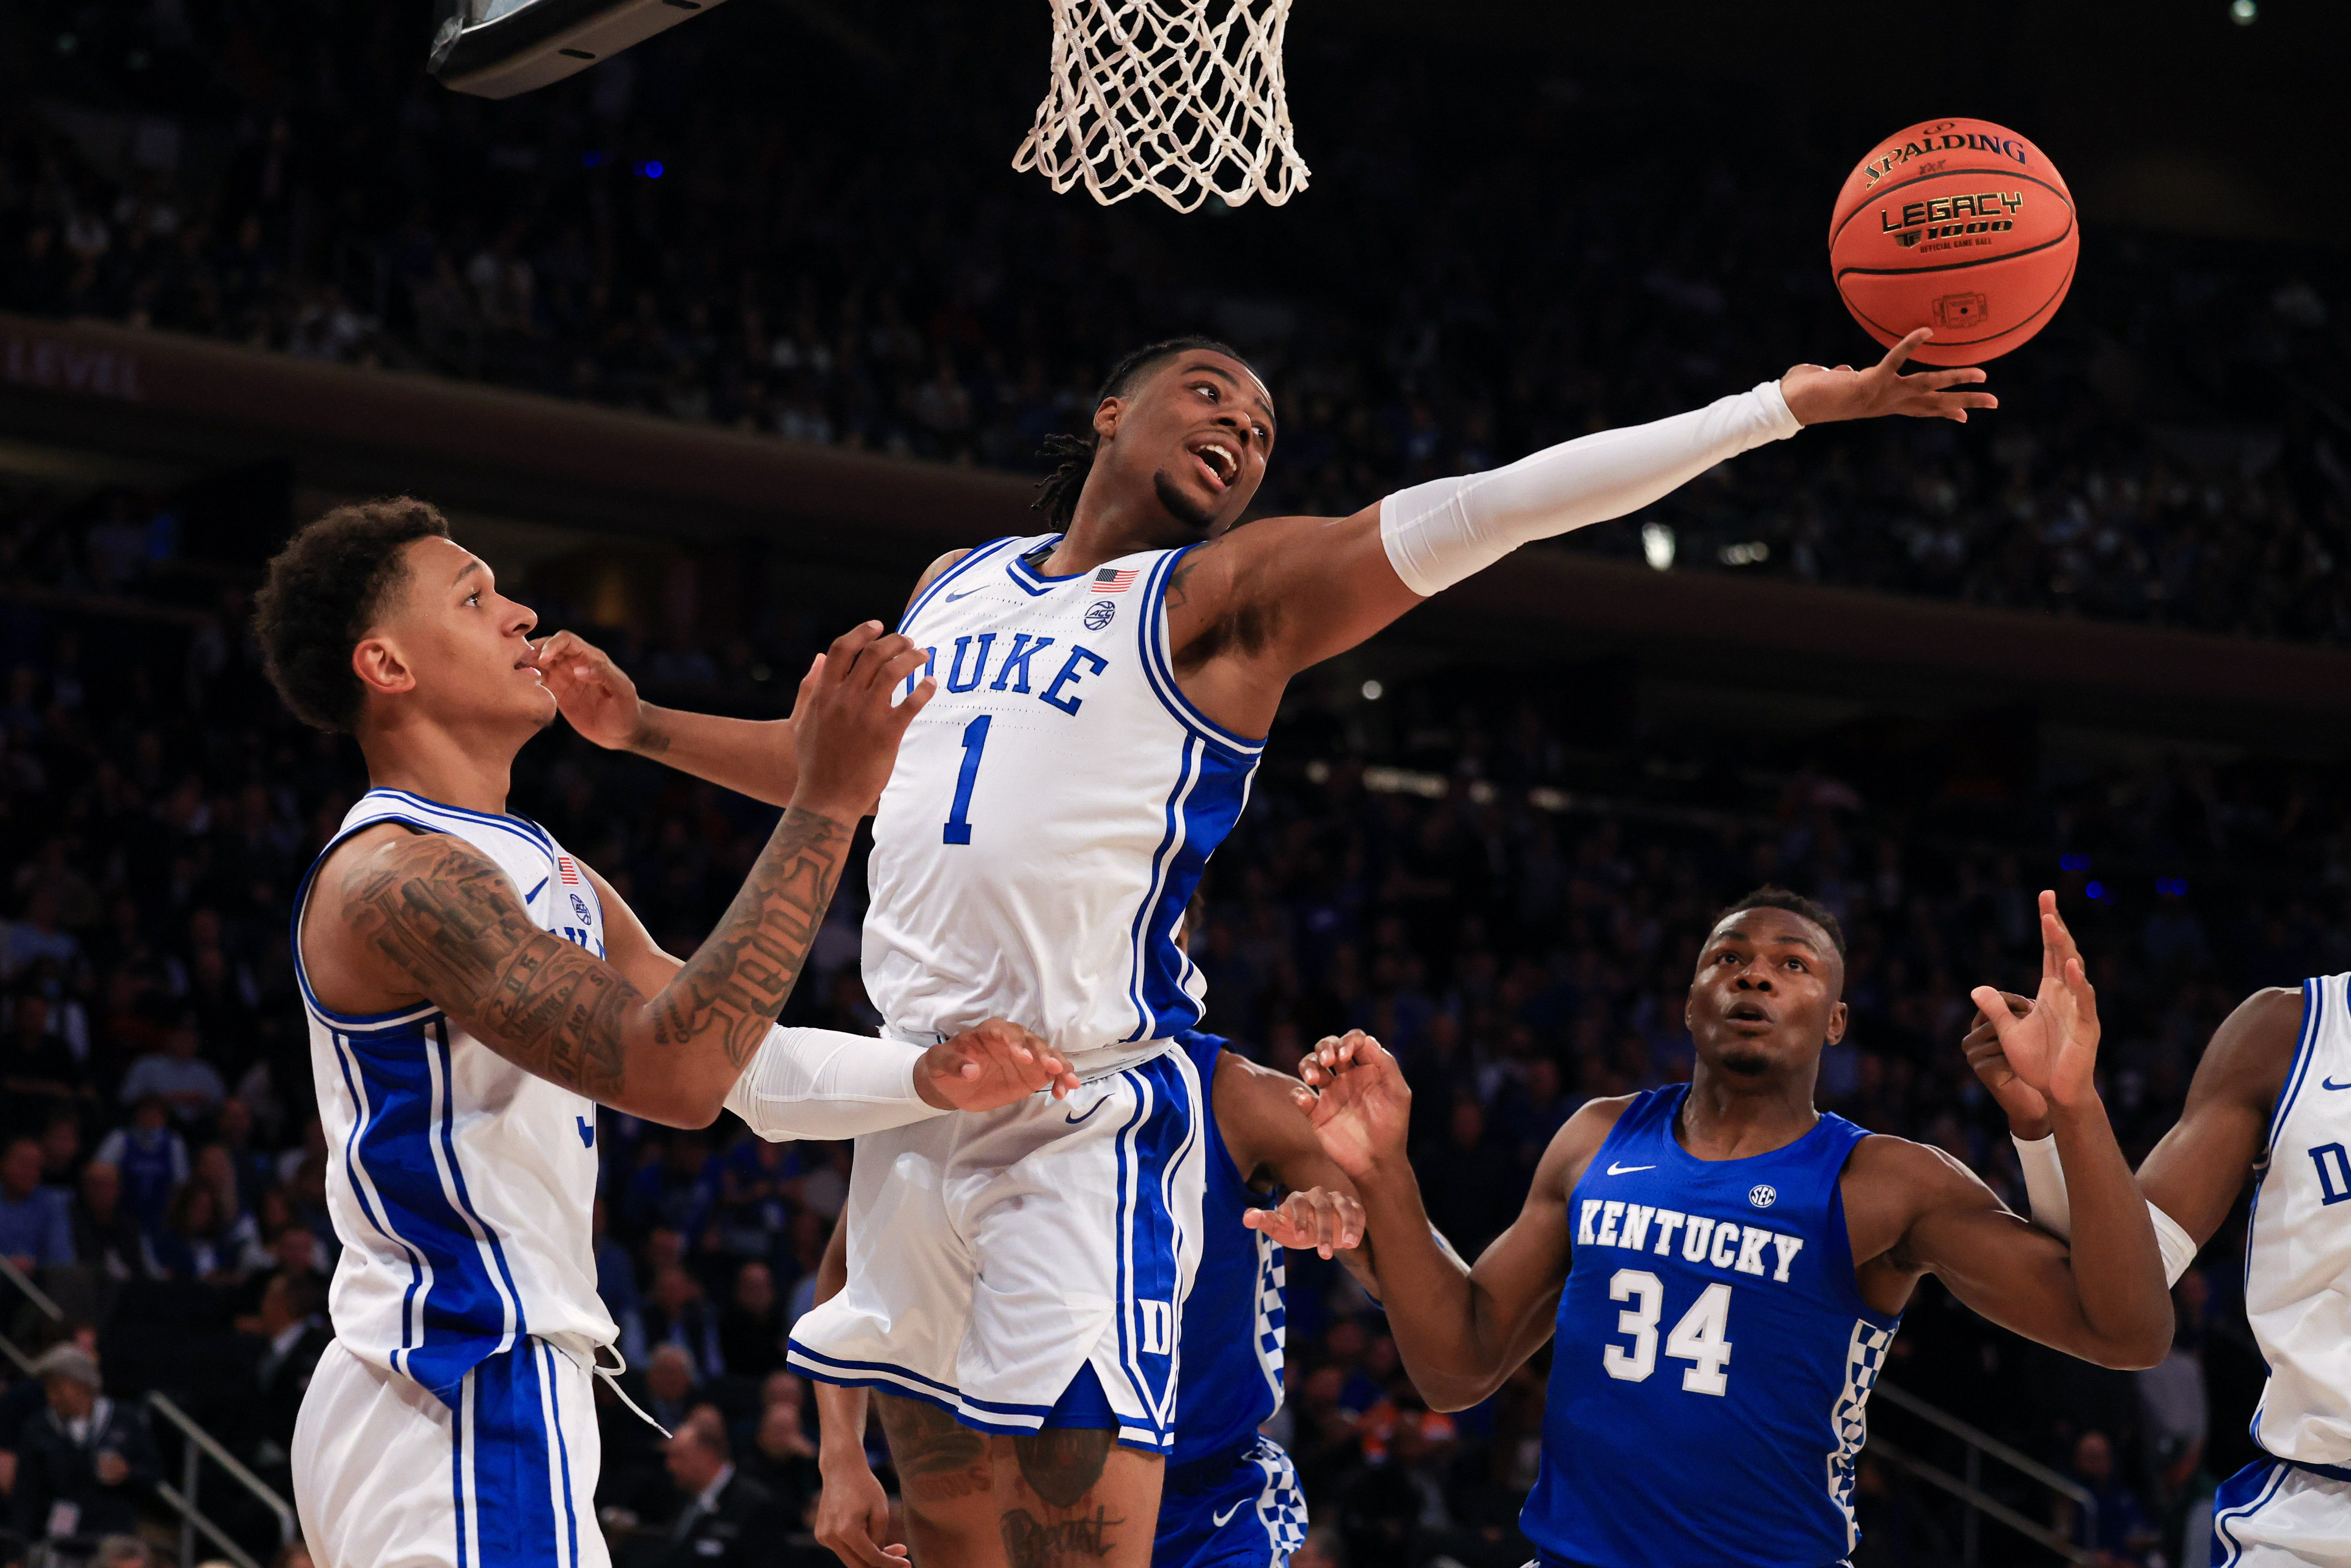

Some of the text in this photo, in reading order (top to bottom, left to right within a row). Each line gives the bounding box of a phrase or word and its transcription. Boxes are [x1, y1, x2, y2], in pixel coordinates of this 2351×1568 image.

[1863, 134, 2027, 191] SPALDING
[1881, 191, 2024, 234] LEGACY
[1927, 218, 2013, 241] 1000
[1920, 237, 1992, 253] OFFICIAL GAME BALL
[943, 715, 992, 845] 1
[1751, 1186, 1774, 1206] SEC
[1577, 1199, 1804, 1283] KENTUCKY
[1138, 1298, 1171, 1356] D
[1603, 1268, 1732, 1397] 34
